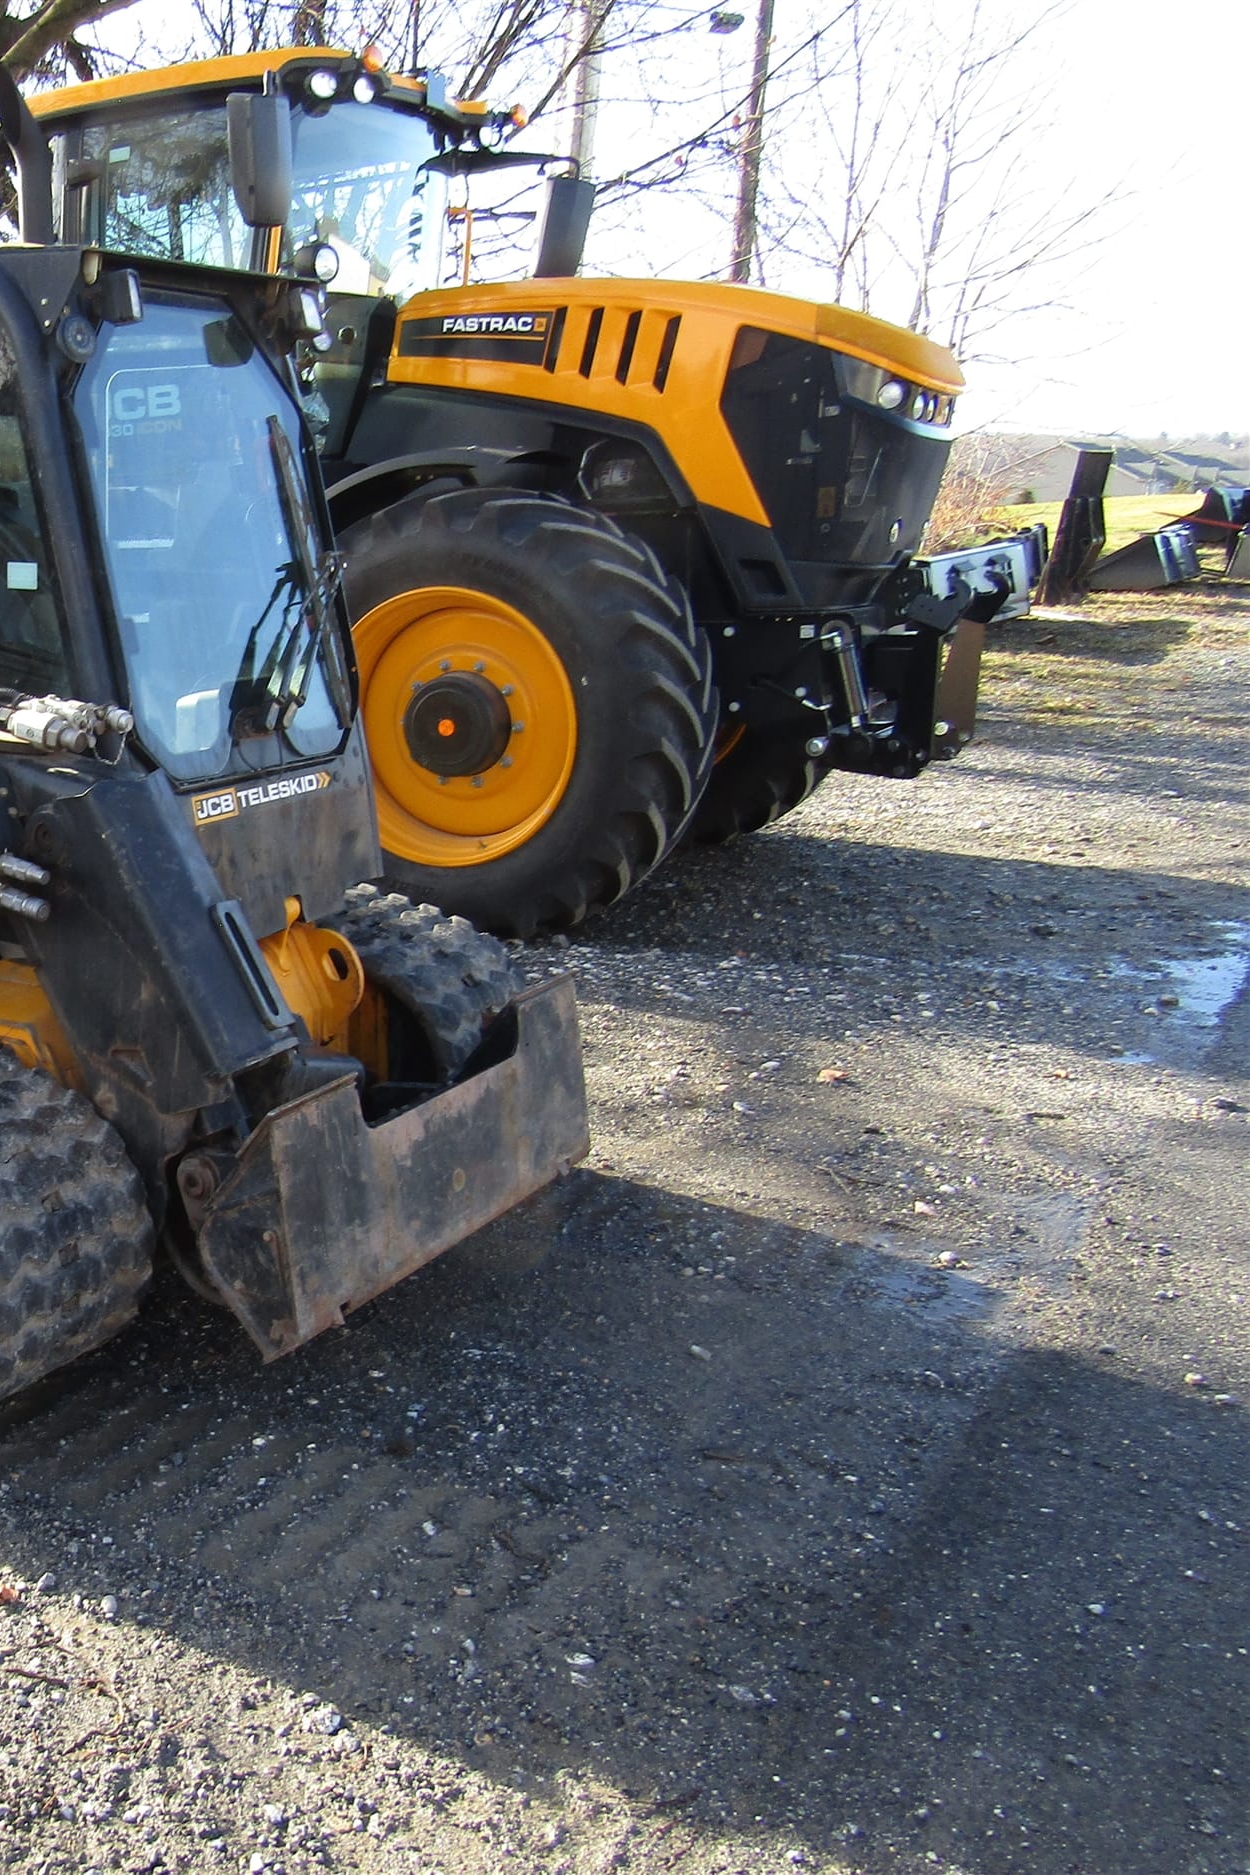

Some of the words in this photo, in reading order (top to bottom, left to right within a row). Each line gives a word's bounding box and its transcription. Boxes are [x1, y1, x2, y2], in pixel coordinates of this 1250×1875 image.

[442, 316, 533, 332] FASTRAC
[109, 423, 135, 437] 30
[196, 794, 235, 819] JCB
[237, 774, 318, 808] TELESKID
